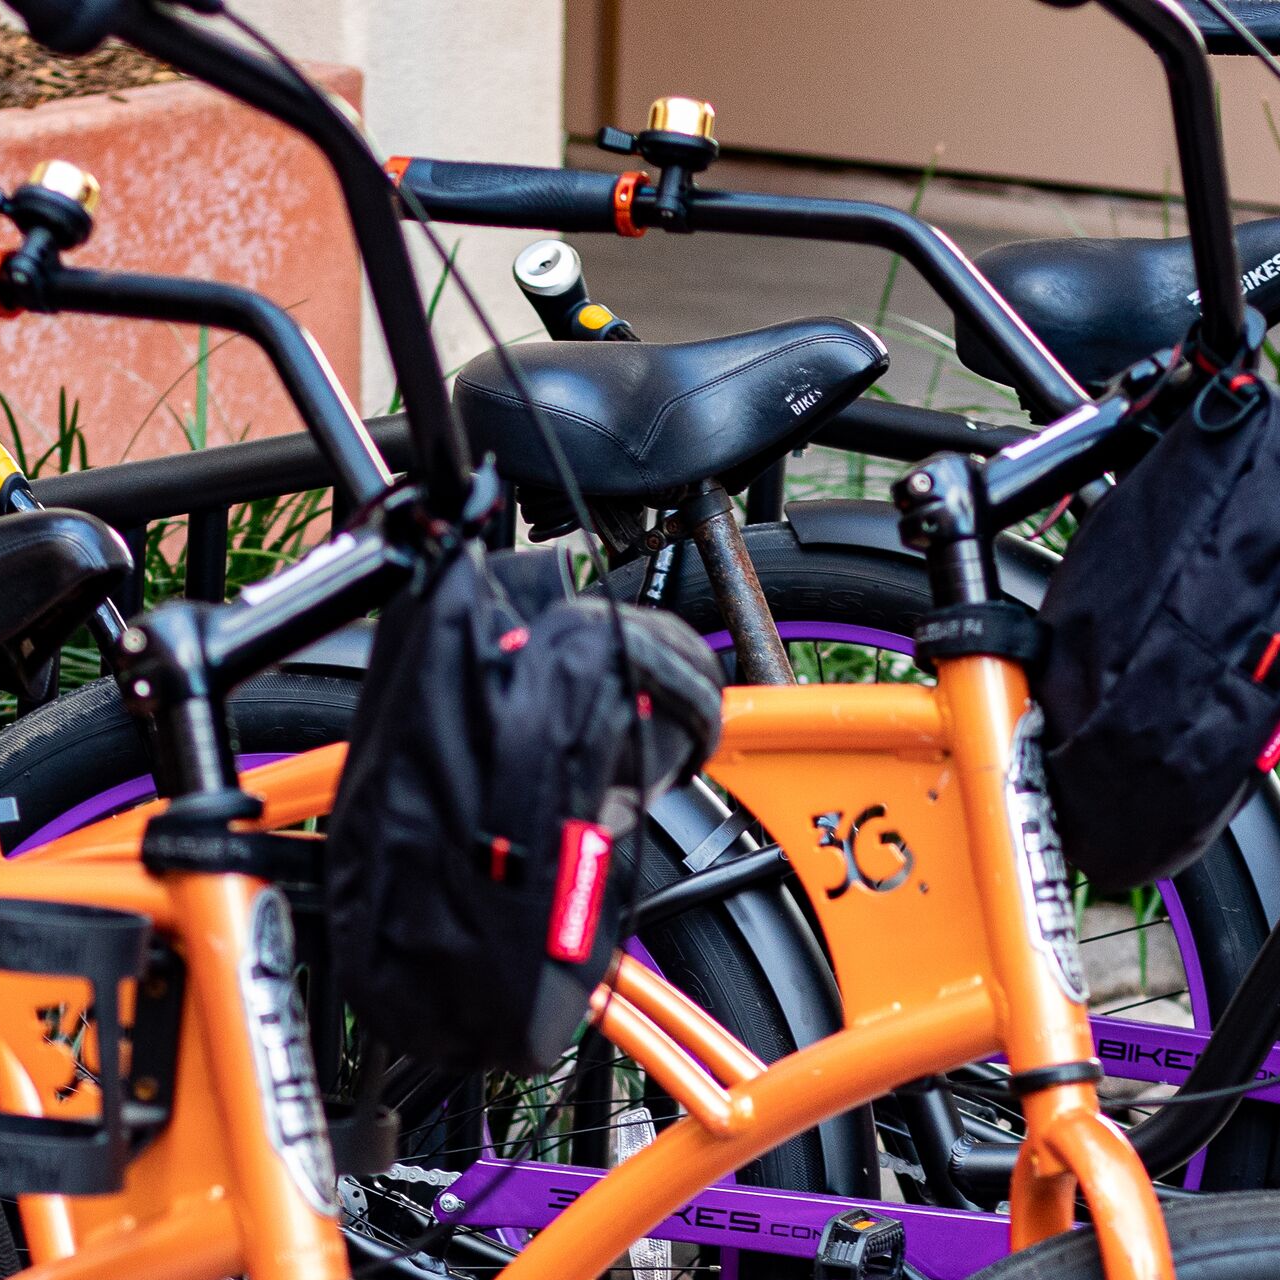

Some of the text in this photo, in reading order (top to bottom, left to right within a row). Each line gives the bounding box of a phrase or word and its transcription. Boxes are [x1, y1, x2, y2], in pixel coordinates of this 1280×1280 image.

[790, 389, 823, 416] BIKES
[811, 804, 914, 900] 3G
[1098, 1038, 1204, 1071] BIKE
